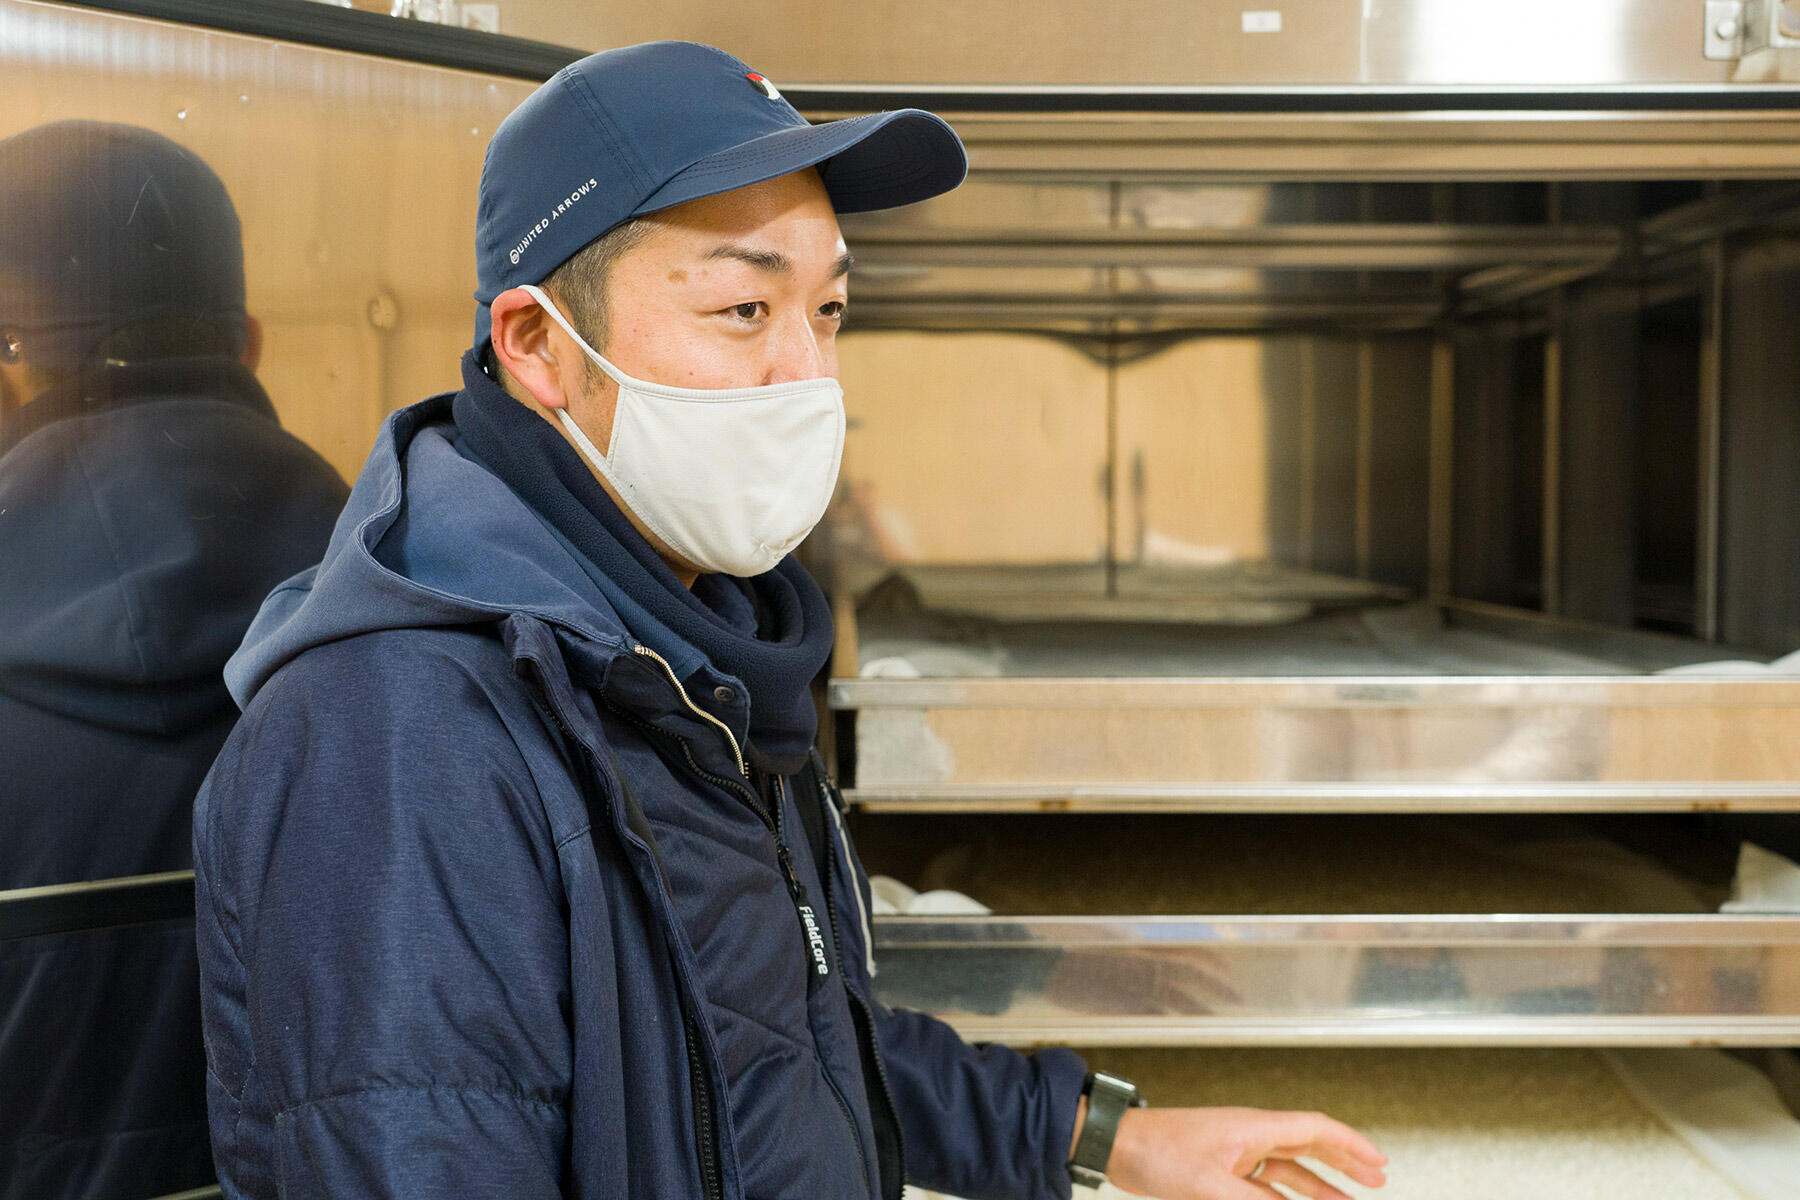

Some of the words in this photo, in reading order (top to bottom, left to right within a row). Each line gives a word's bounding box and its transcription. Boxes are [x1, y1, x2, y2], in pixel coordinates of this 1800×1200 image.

[516, 218, 549, 254] UNITED
[552, 178, 598, 220] ARROWS
[799, 906, 828, 975] FieldCore
